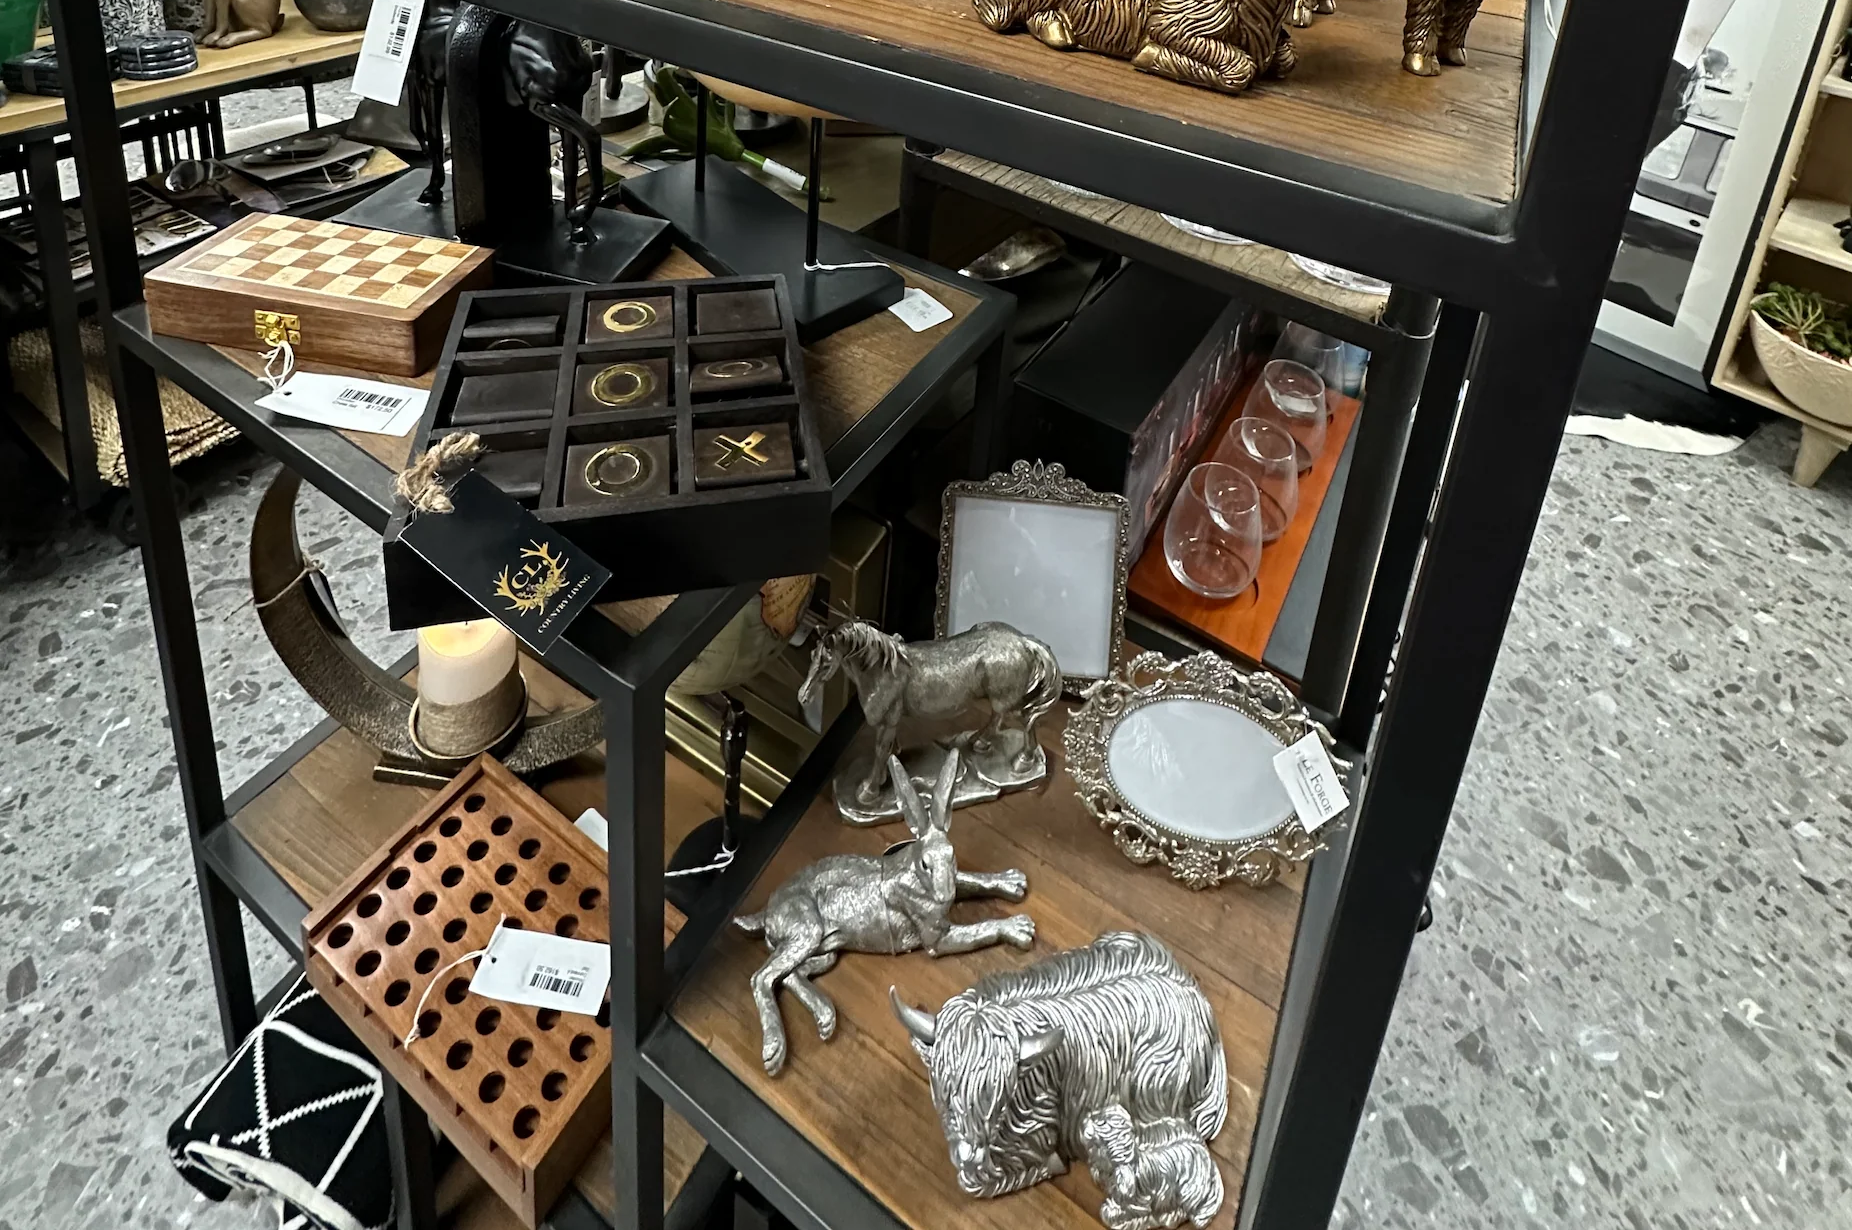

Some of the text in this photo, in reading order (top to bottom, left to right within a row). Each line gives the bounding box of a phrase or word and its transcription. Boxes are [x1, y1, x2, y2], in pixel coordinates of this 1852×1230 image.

[537, 573, 591, 634] COUNTRY LIVING
[1310, 772, 1333, 815] FORGE
